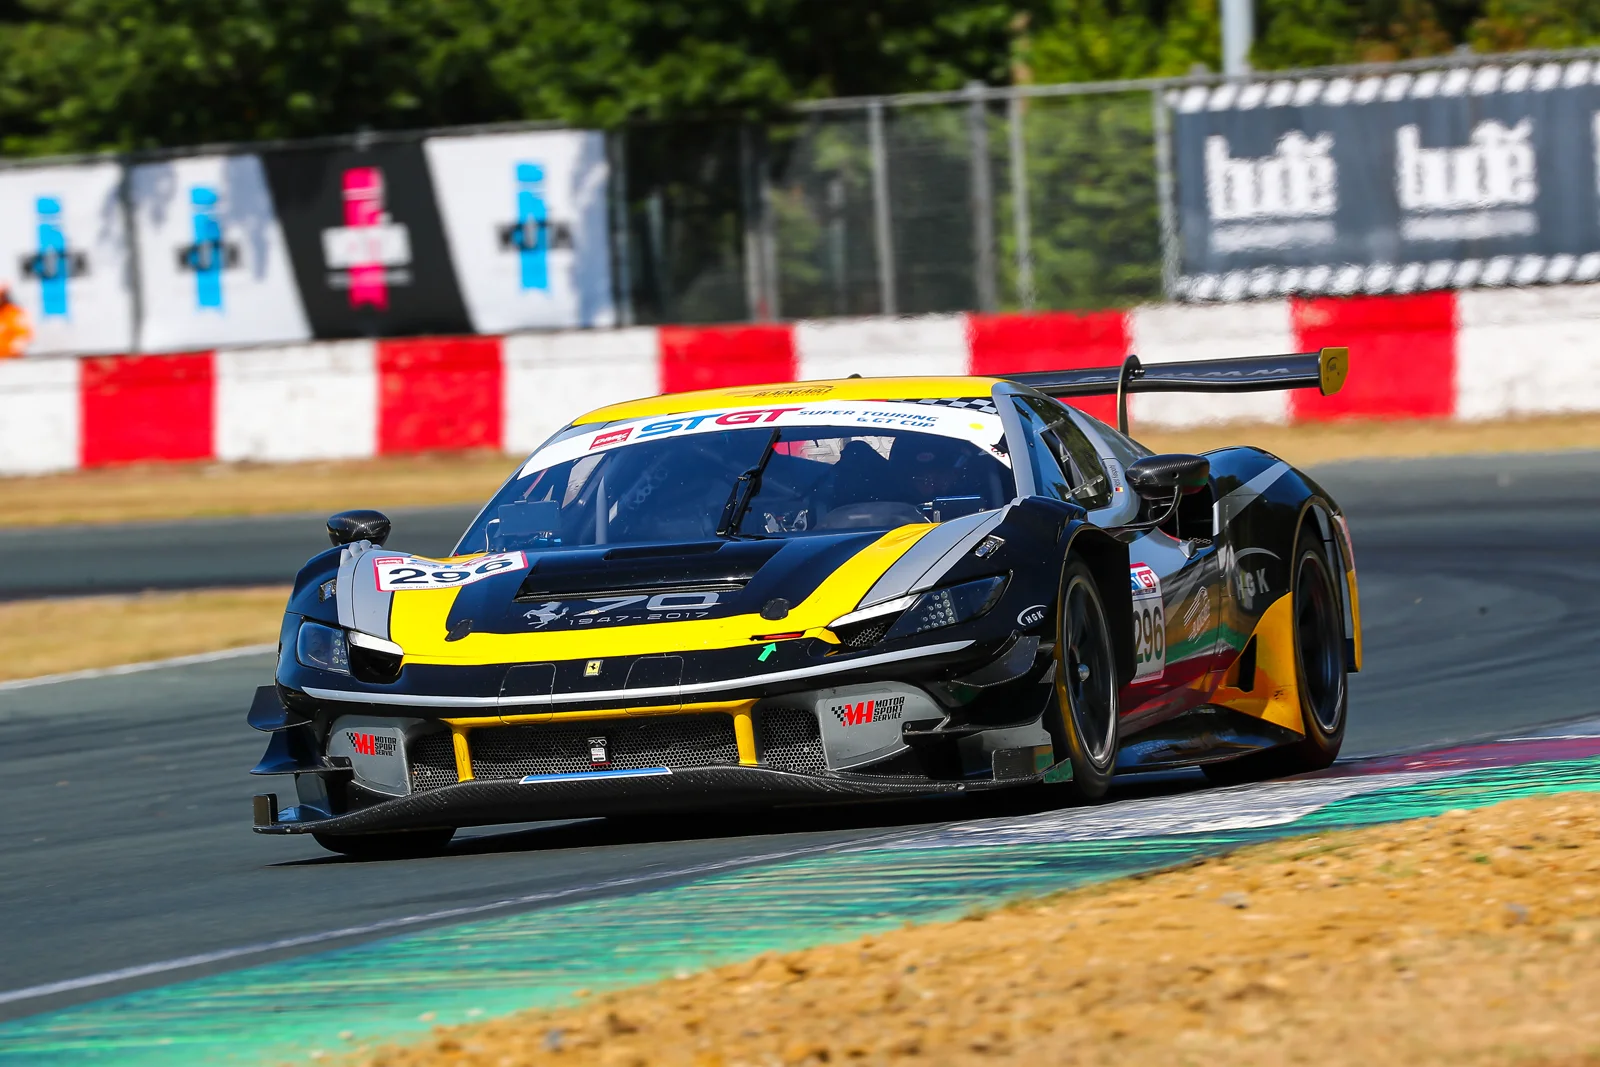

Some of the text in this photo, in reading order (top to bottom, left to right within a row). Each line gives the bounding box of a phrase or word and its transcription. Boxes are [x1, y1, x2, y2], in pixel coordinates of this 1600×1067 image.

[635, 407, 806, 439] STGT
[862, 411, 939, 422] TOURING
[388, 558, 514, 585] 296
[574, 592, 720, 616] 70
[569, 611, 709, 626] 1947-2017
[1025, 610, 1044, 624] HGK
[1133, 606, 1164, 664] 296
[875, 696, 905, 708] MOTOR
[874, 704, 904, 716] SPORT
[374, 736, 397, 744] MOTOR
[374, 743, 396, 751] SPORT
